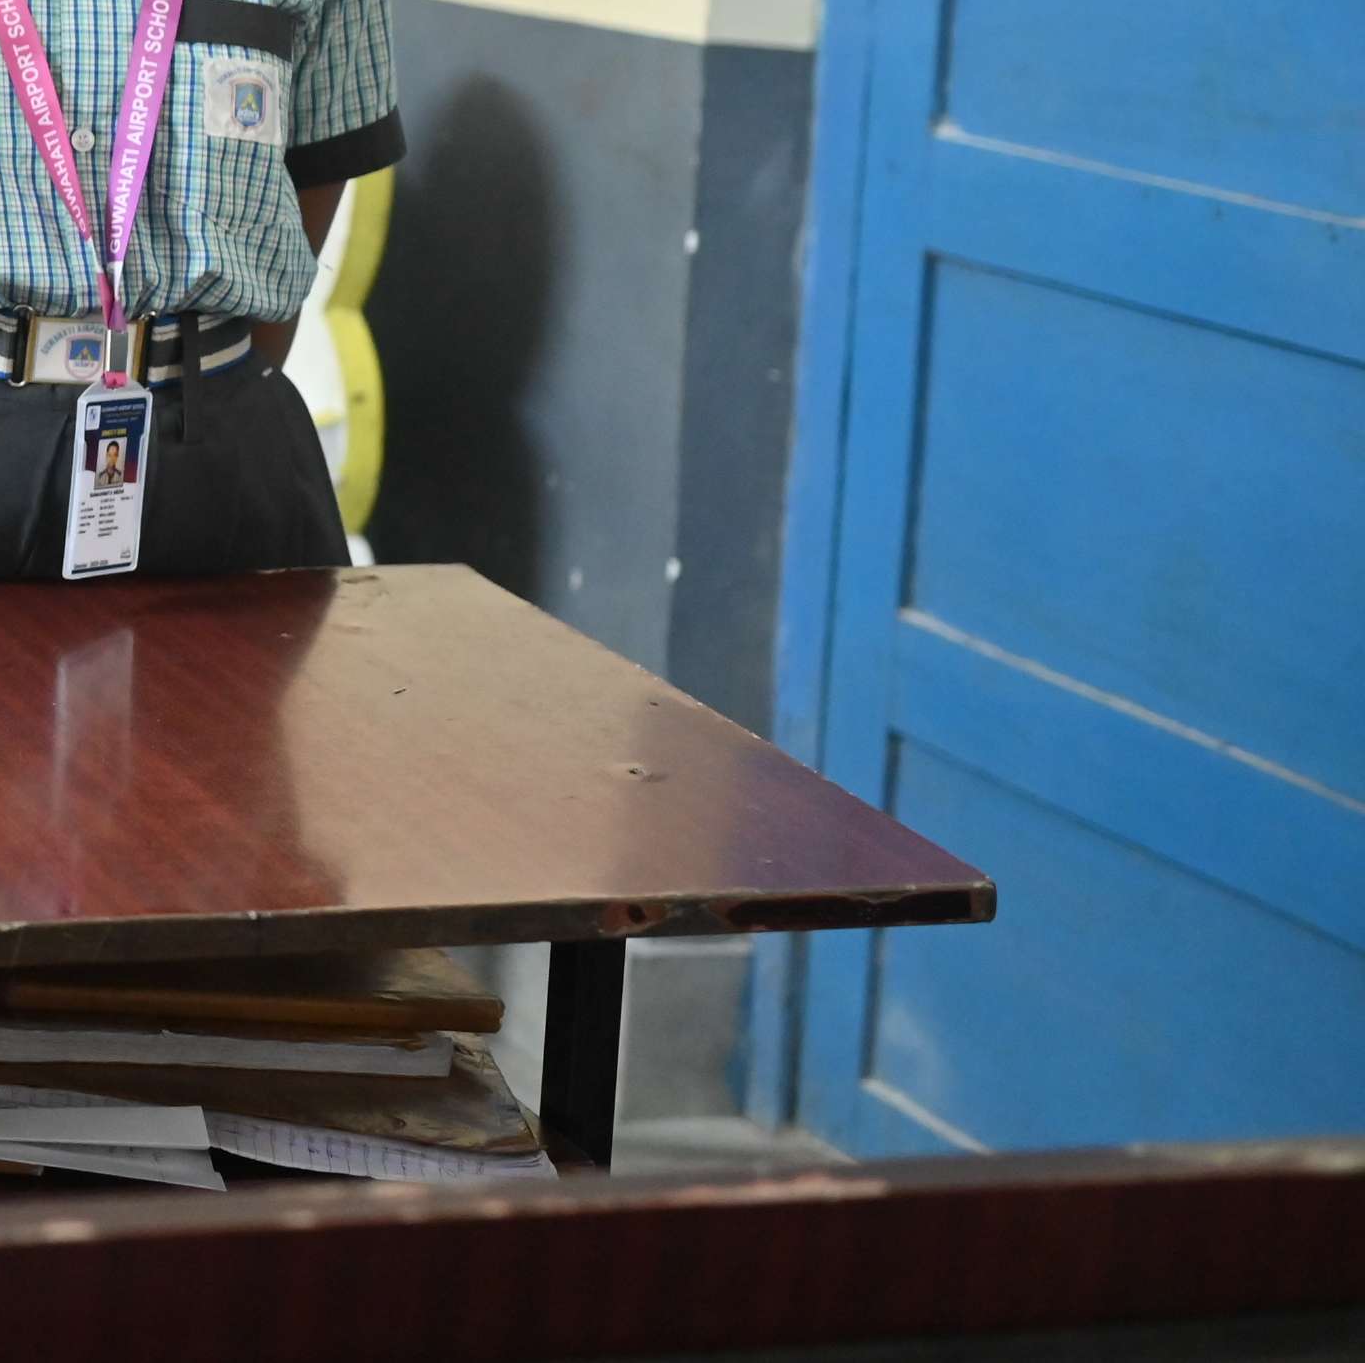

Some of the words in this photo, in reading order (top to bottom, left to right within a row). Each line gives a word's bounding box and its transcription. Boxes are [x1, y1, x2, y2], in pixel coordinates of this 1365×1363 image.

[12, 43, 54, 128] AIRPORT
[42, 130, 87, 233] GUWAHATI
[109, 149, 140, 254] GUWAHATI
[127, 55, 159, 146] AIRPORT
